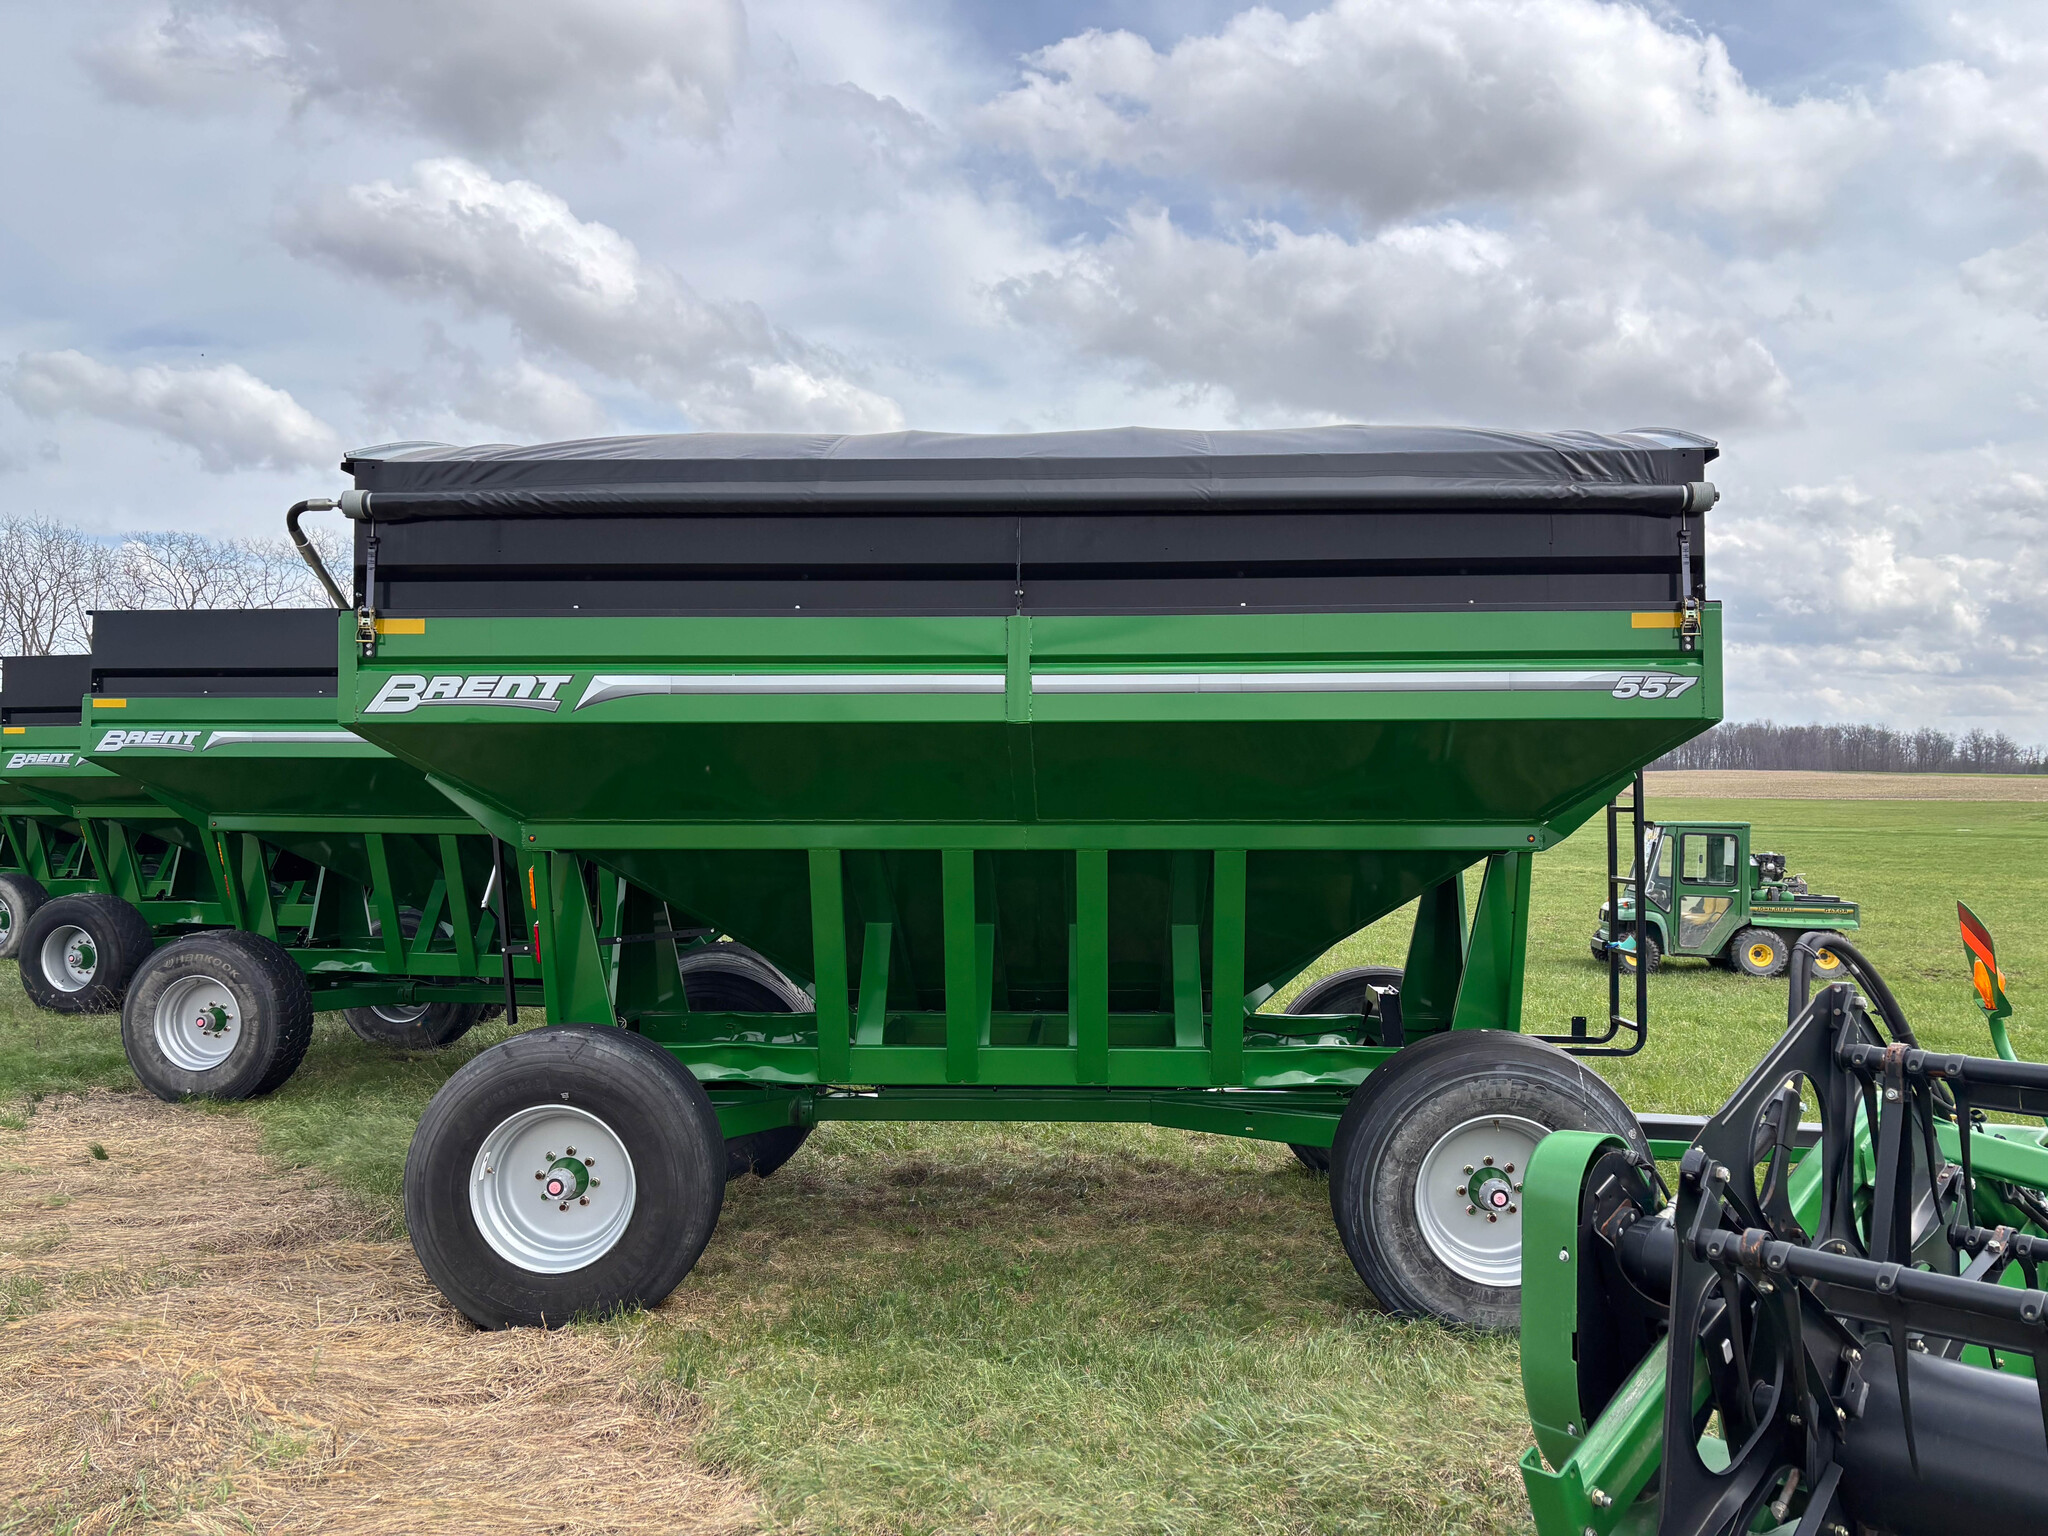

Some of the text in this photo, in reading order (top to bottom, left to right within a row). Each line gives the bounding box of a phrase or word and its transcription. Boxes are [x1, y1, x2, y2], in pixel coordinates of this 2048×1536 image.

[361, 673, 575, 714] BRENT
[1611, 675, 1699, 699] 557
[93, 729, 202, 752] BRENT
[5, 753, 74, 769] BRENT
